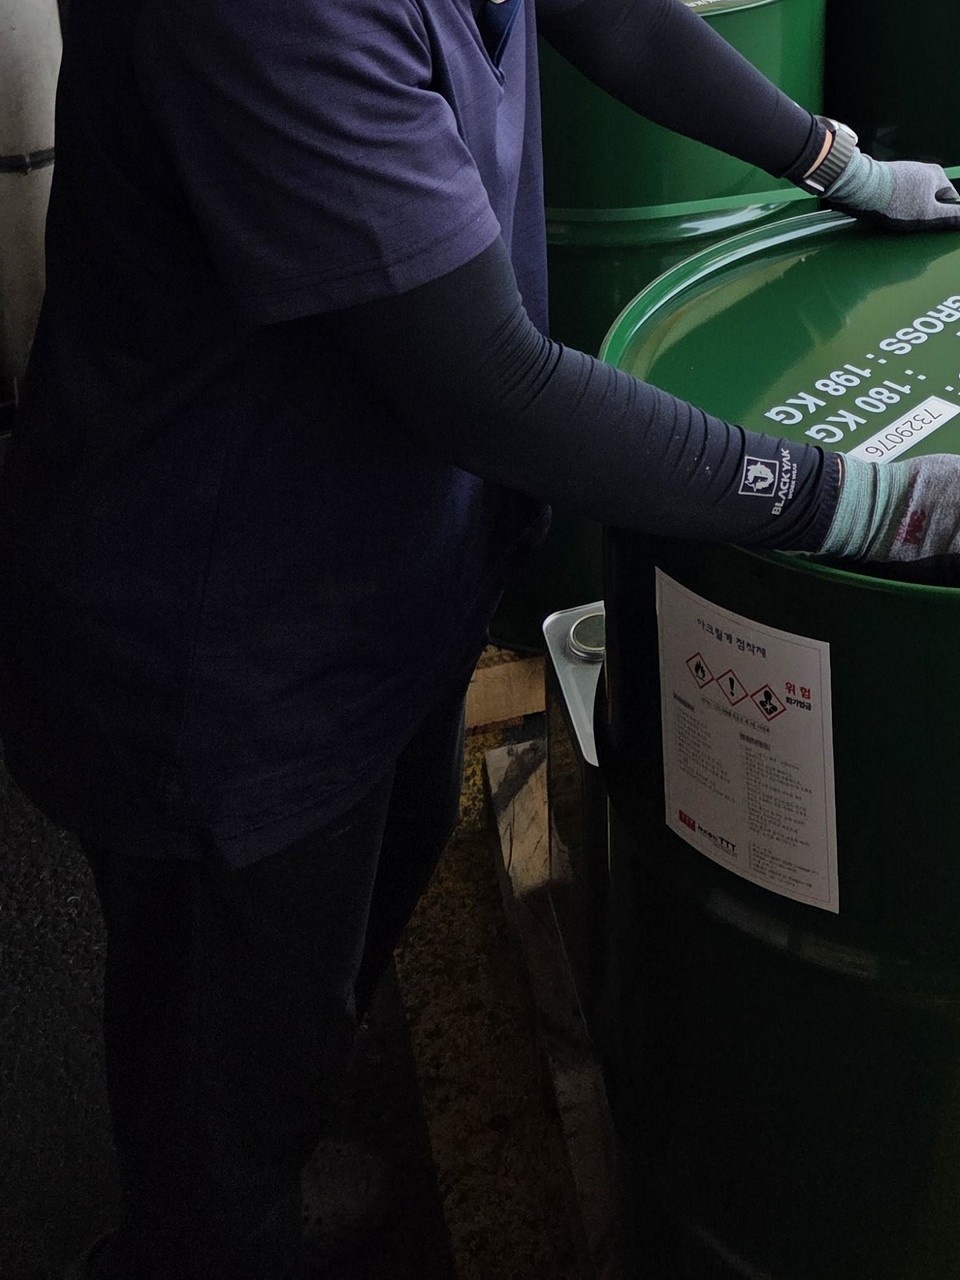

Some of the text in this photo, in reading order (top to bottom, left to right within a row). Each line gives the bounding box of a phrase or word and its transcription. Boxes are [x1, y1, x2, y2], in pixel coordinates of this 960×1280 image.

[815, 363, 872, 396] 198
[764, 392, 827, 425] KG
[854, 380, 911, 413] 180
[804, 409, 867, 444] KG
[864, 408, 943, 459] 7329076
[718, 836, 736, 851] TTT
